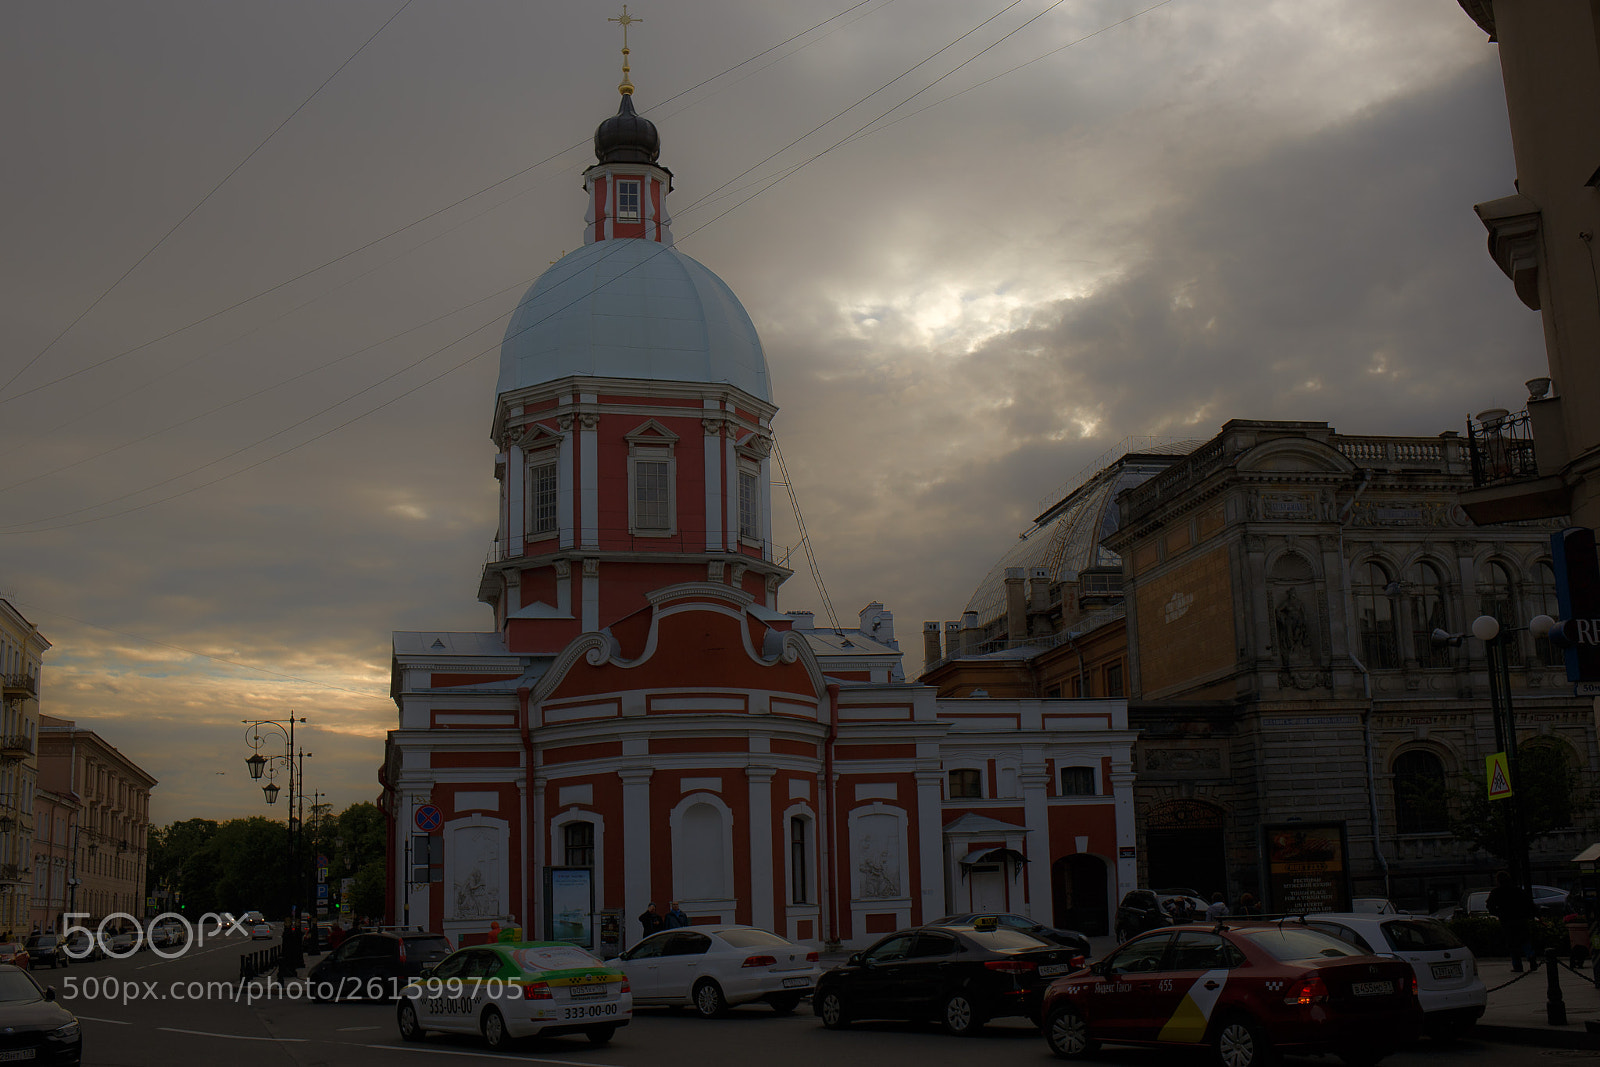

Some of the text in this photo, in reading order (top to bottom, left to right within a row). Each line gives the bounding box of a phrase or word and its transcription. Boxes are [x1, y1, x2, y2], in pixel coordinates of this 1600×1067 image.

[1158, 979, 1173, 992] 455
[429, 997, 472, 1014] 333-00-00
[565, 1003, 617, 1020] 333-00-00
